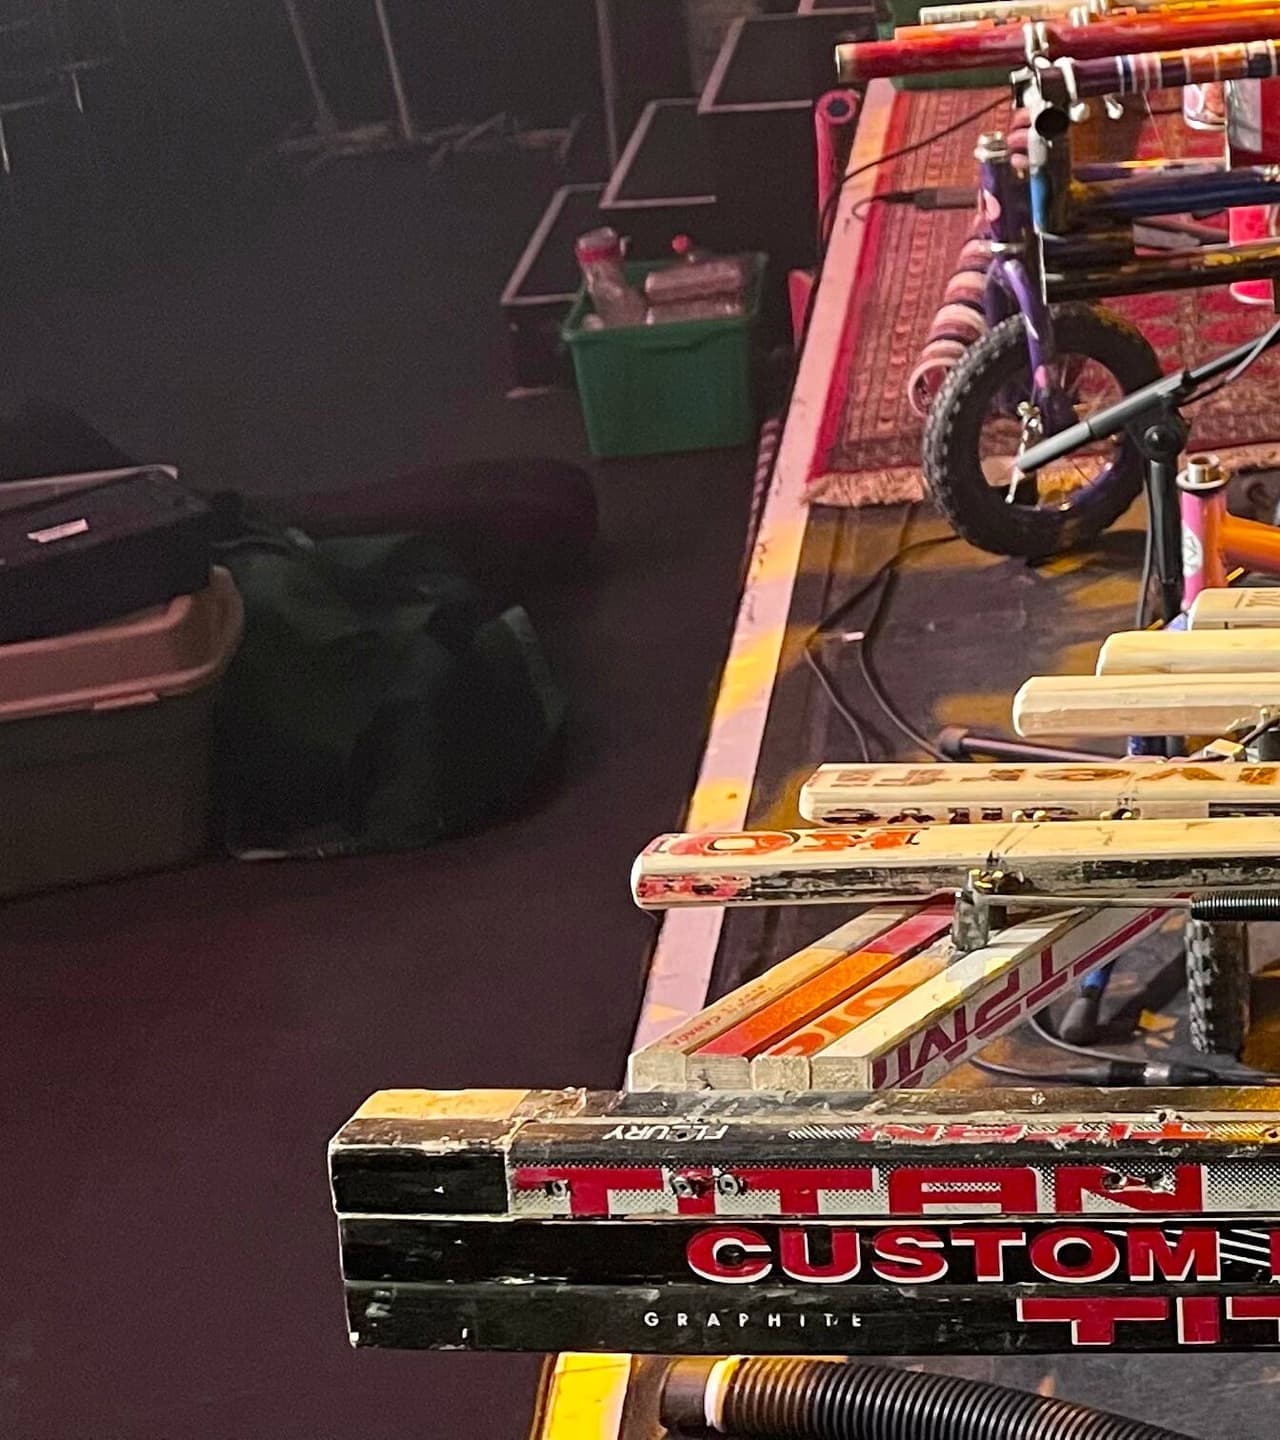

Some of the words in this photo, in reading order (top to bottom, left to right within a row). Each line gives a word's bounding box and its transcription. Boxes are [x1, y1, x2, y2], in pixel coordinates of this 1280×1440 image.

[601, 1124, 729, 1142] FLURY
[512, 1162, 1207, 1216] TITAN
[686, 1225, 1223, 1283] CUSTOM
[643, 1311, 865, 1329] GRAPHITE
